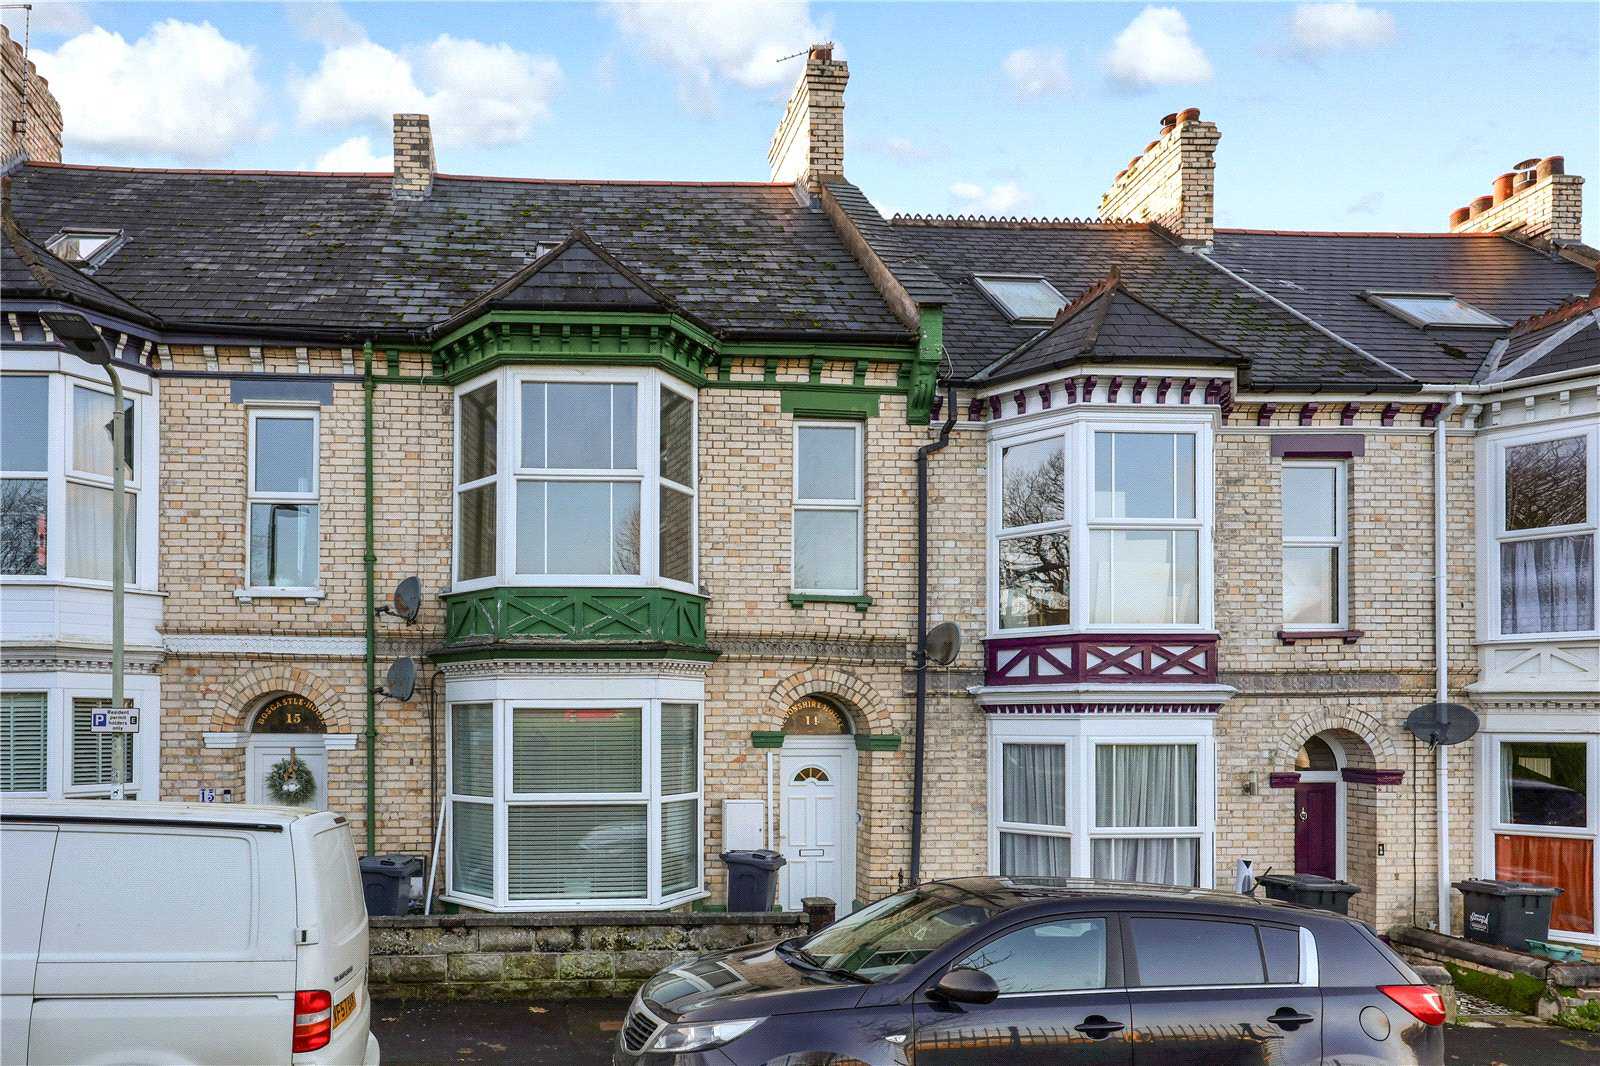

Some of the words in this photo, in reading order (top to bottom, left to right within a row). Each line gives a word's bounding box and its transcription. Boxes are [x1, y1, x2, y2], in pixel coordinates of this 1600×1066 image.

[95, 714, 104, 726] P
[286, 713, 302, 724] 15
[781, 700, 821, 729] VONSHIRE
[200, 789, 214, 803] 15
